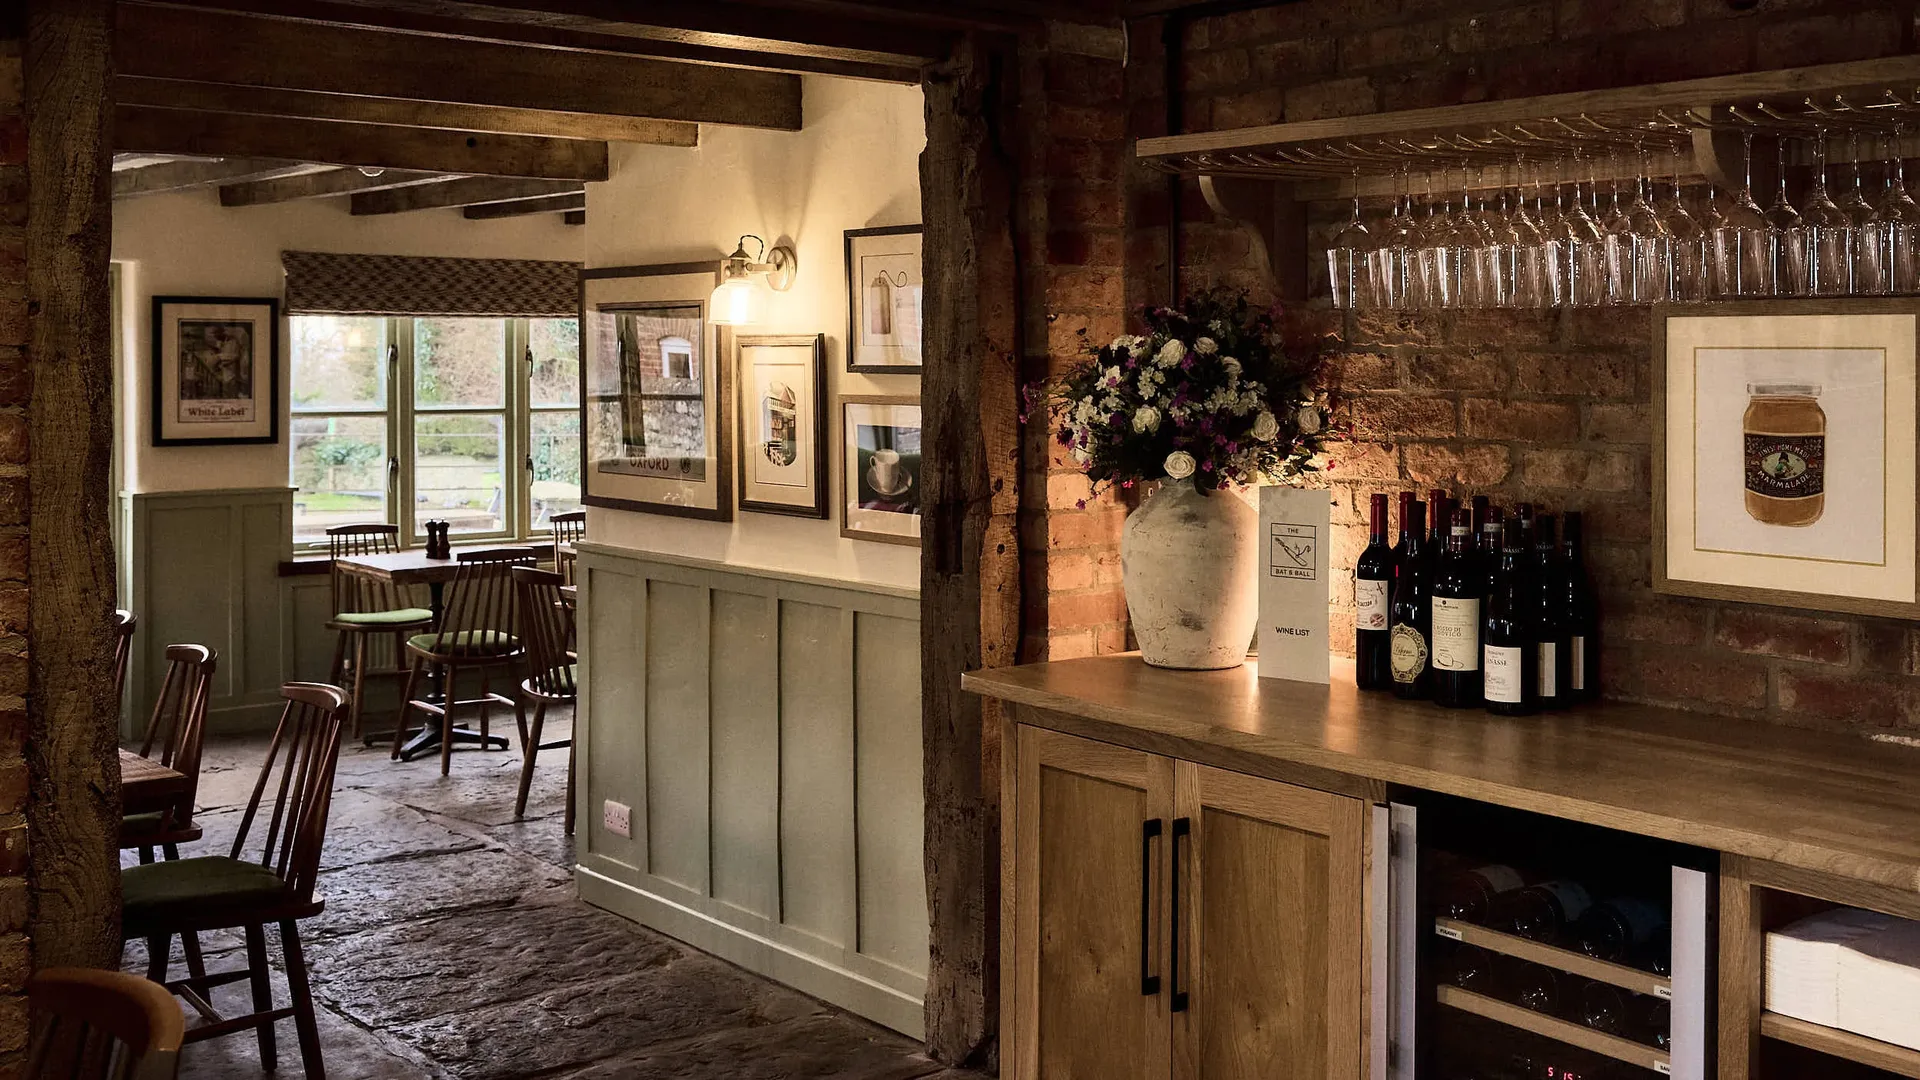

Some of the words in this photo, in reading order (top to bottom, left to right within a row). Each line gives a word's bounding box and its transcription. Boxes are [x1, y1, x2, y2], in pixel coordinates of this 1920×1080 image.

[630, 454, 669, 471] OXFORD
[1757, 469, 1811, 489] MARMALADE
[1275, 626, 1294, 635] WINE
[1295, 627, 1310, 636] LIST
